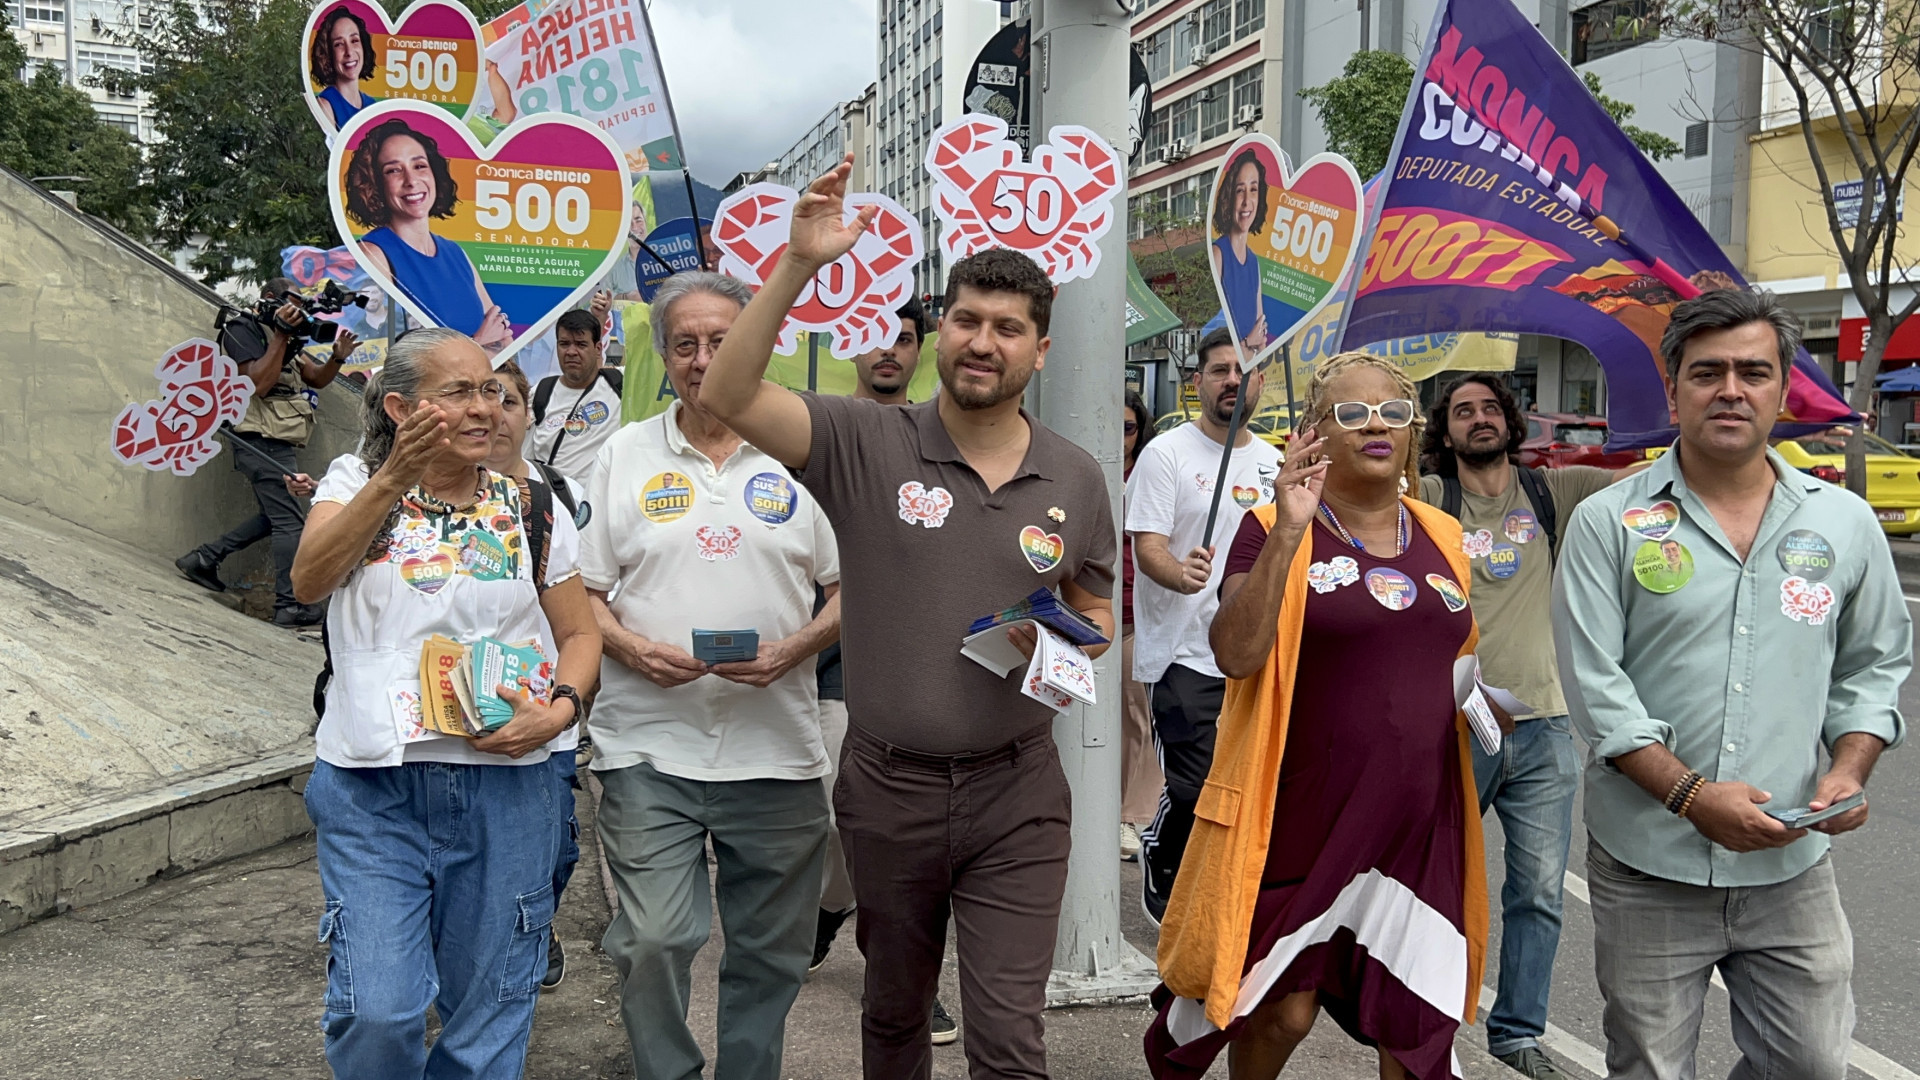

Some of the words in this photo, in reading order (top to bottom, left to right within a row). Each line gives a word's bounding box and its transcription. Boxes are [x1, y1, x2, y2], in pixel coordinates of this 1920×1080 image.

[386, 49, 457, 93] 500
[384, 90, 457, 103] SENADORA
[475, 179, 590, 235] 500
[987, 175, 1062, 236] 50
[1397, 156, 1500, 192] DEPUTADA
[1499, 181, 1611, 247] ESTADUAL
[475, 232, 590, 248] SENADORA
[1270, 206, 1334, 265] 500
[649, 236, 692, 255] Paulo
[480, 263, 512, 273] MARIA
[516, 266, 535, 274] DOS
[484, 254, 541, 265] VANDERLEA
[544, 258, 580, 267] AGUIAR
[1266, 250, 1325, 279] SENADORA
[1262, 277, 1279, 288] MARIA
[1279, 284, 1290, 294] DOS
[1266, 270, 1295, 286] VANDERLEA
[1296, 281, 1316, 295] AGUIAR
[161, 385, 214, 441] 50
[753, 480, 774, 491] SUS
[647, 496, 688, 510] 50111
[754, 498, 788, 513] 50111
[912, 499, 935, 515] 50
[1636, 513, 1667, 527] 500
[710, 537, 729, 551] 50
[1031, 538, 1055, 558] 500
[1786, 542, 1827, 551] ALENCAR
[474, 551, 501, 573] 1818
[1490, 551, 1515, 564] 500
[1785, 554, 1828, 568] 50100
[413, 565, 443, 579] 500
[1637, 563, 1664, 576] 50100
[1798, 595, 1819, 613] 50
[439, 654, 455, 702] 1818
